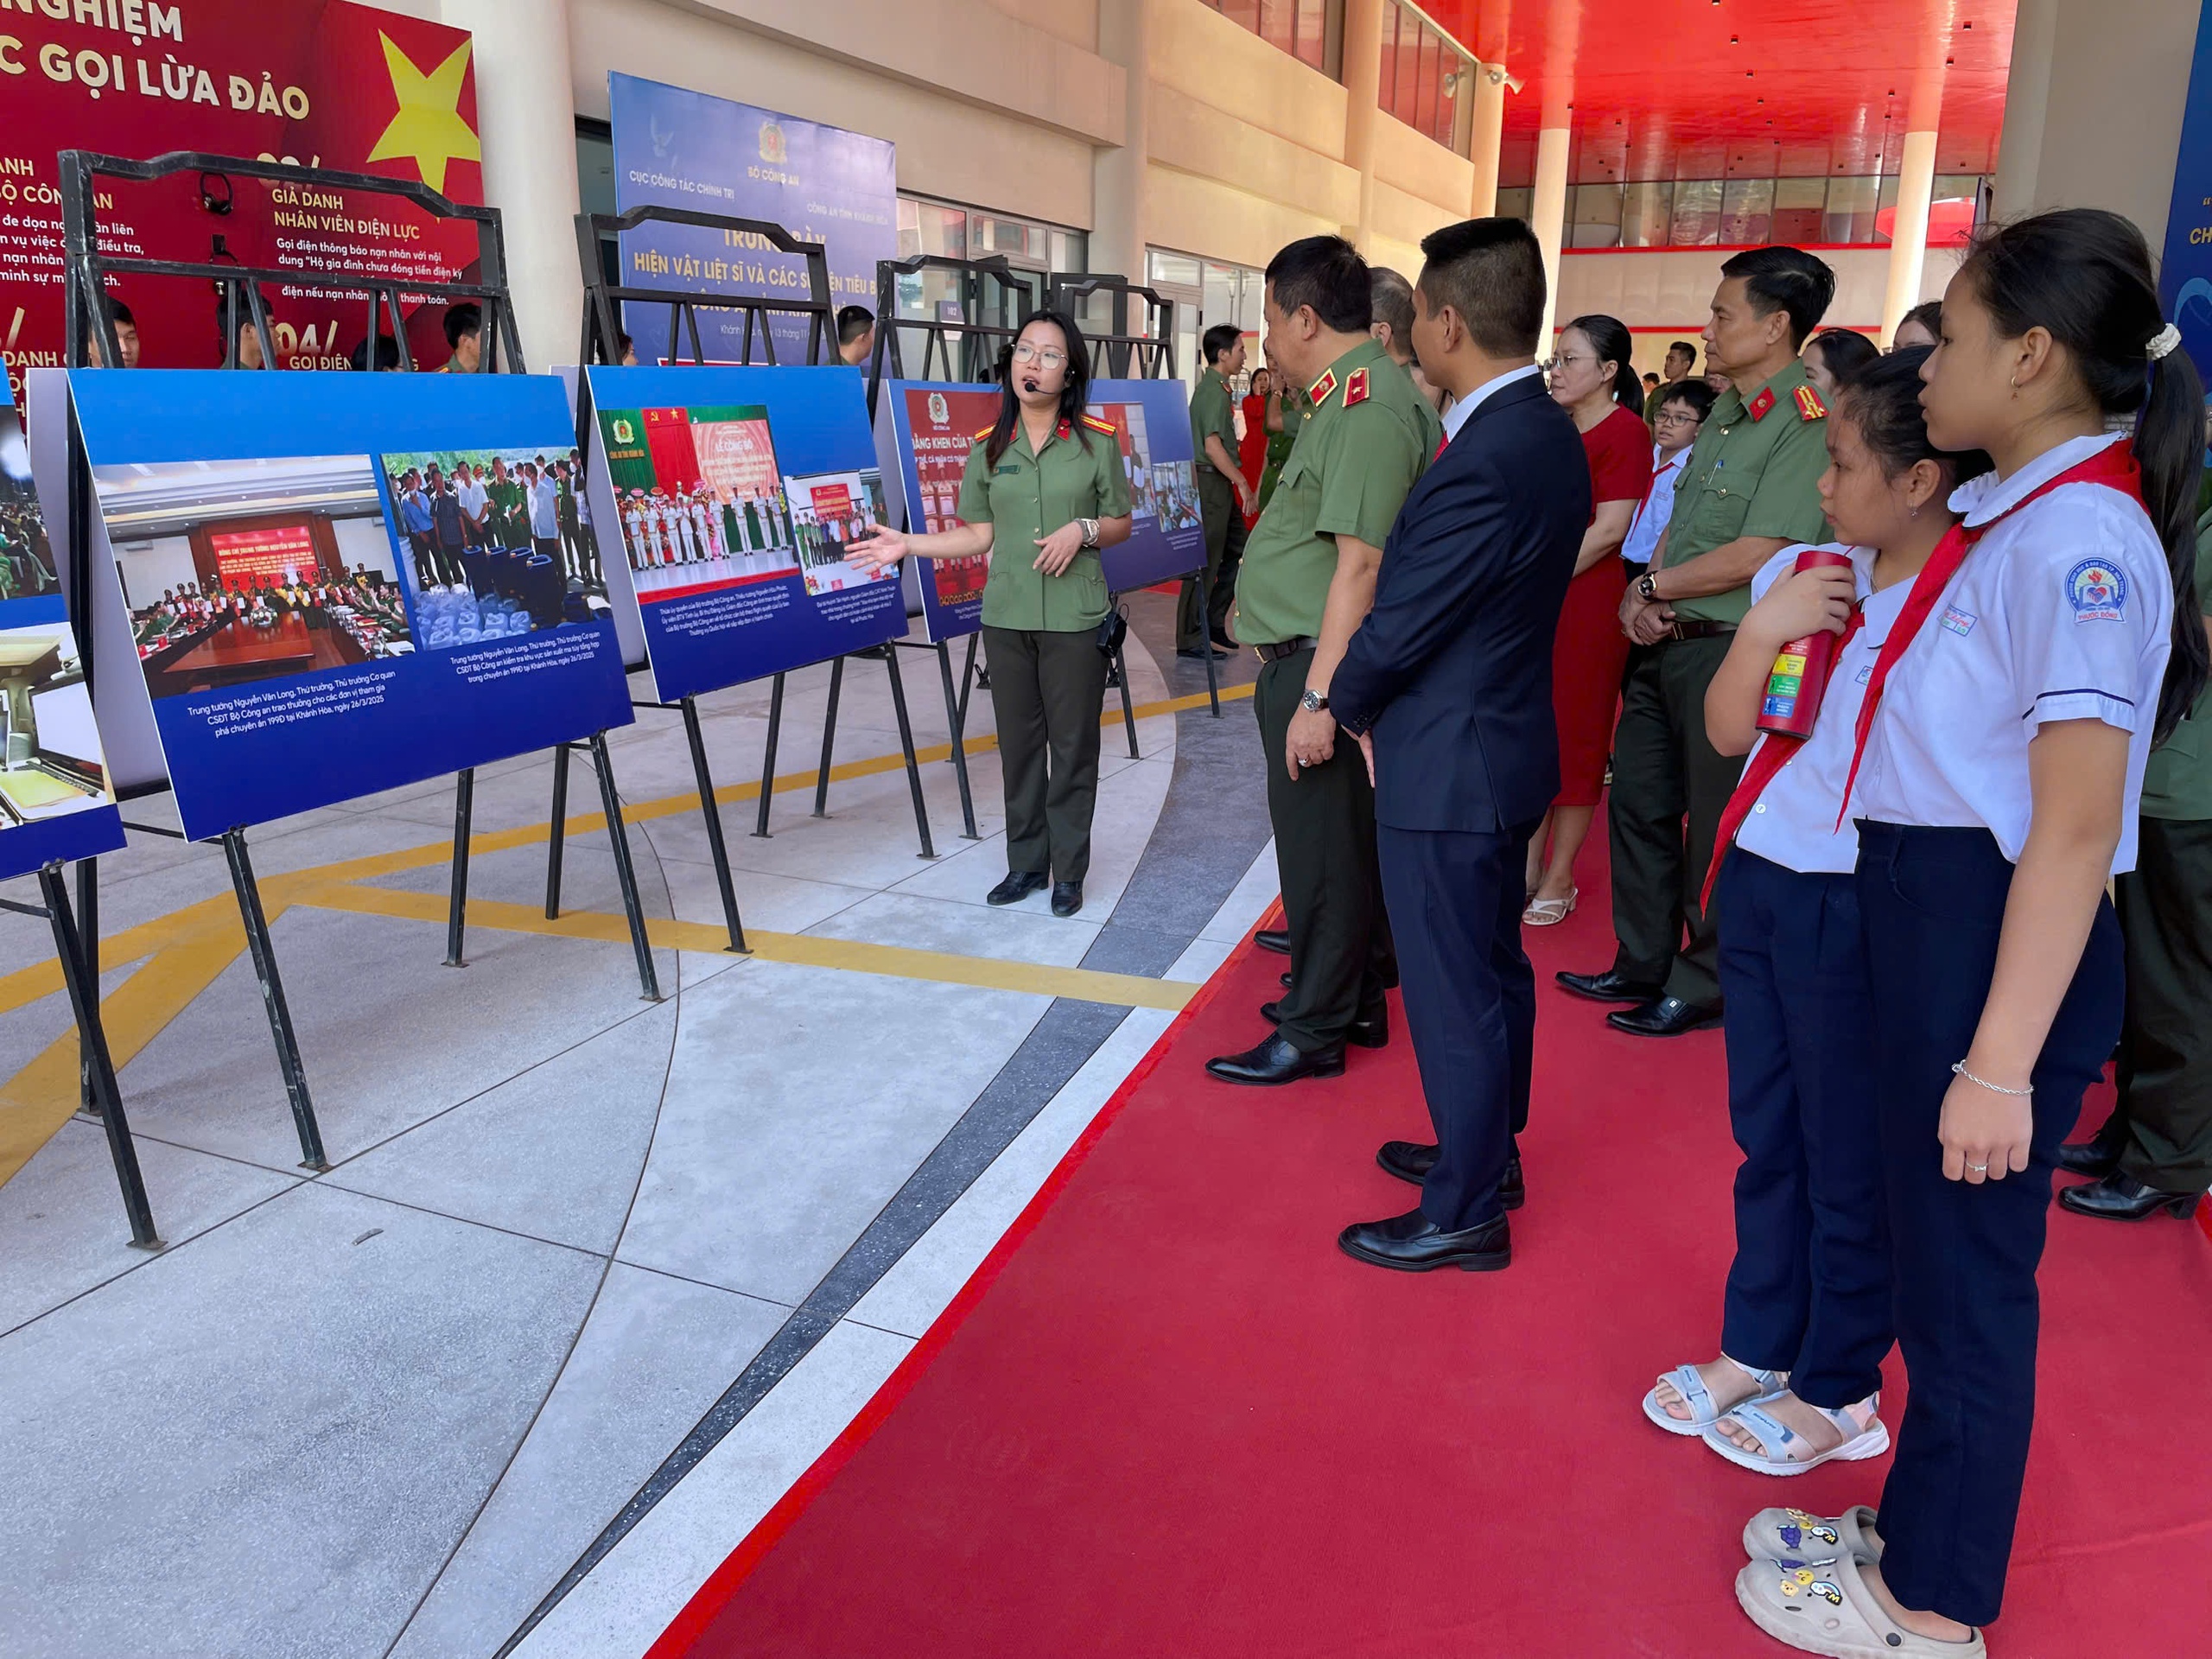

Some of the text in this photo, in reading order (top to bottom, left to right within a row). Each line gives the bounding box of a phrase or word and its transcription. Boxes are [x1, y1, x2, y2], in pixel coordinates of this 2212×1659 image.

[39, 43, 126, 99] GỌI
[137, 54, 220, 105] LỪA
[228, 71, 309, 119] ĐẢO
[23, 182, 63, 205] CÔN
[651, 174, 677, 189] CÔNG
[679, 178, 695, 193] TÁC
[272, 187, 343, 210] GIẢ DANH
[2, 214, 135, 236] đe dọa liên
[274, 210, 421, 242] NHÂN VIÊN ĐIỆN LỰC
[11, 237, 28, 249] vụ
[31, 235, 57, 250] việc
[124, 243, 144, 255] tra,
[276, 238, 442, 264] Gọi điện thông báo nạn nhân với nội
[3, 253, 64, 267] nạn nhân
[278, 254, 304, 267] dung
[327, 260, 341, 271] gia
[344, 257, 364, 270] đình
[366, 263, 389, 273] chưa
[391, 262, 413, 276] đóng
[415, 264, 431, 276] tiền
[434, 265, 452, 279] điện
[33, 274, 48, 286] sự
[634, 249, 669, 278] HIỆN
[673, 253, 701, 282] VẬT
[704, 257, 728, 285] LIỆT
[732, 261, 743, 283] SĨ
[747, 263, 766, 284] VÀ
[769, 265, 798, 288] CÁC
[846, 274, 867, 296] TIÊU
[282, 285, 303, 299] điện
[306, 288, 323, 300] nếu
[326, 290, 344, 302] nạn
[346, 289, 369, 302] nhân
[400, 292, 426, 305] thanh
[428, 294, 449, 306] toán.
[275, 320, 338, 354] 04/
[3, 351, 58, 367] DANH
[234, 696, 262, 708] Nguyễn
[208, 714, 227, 724] CSĐT
[230, 712, 240, 721] Bộ
[216, 728, 229, 738] phá
[231, 722, 257, 733] chuyên
[296, 710, 317, 719] Khánh
[352, 696, 384, 708] 26/3/2025
